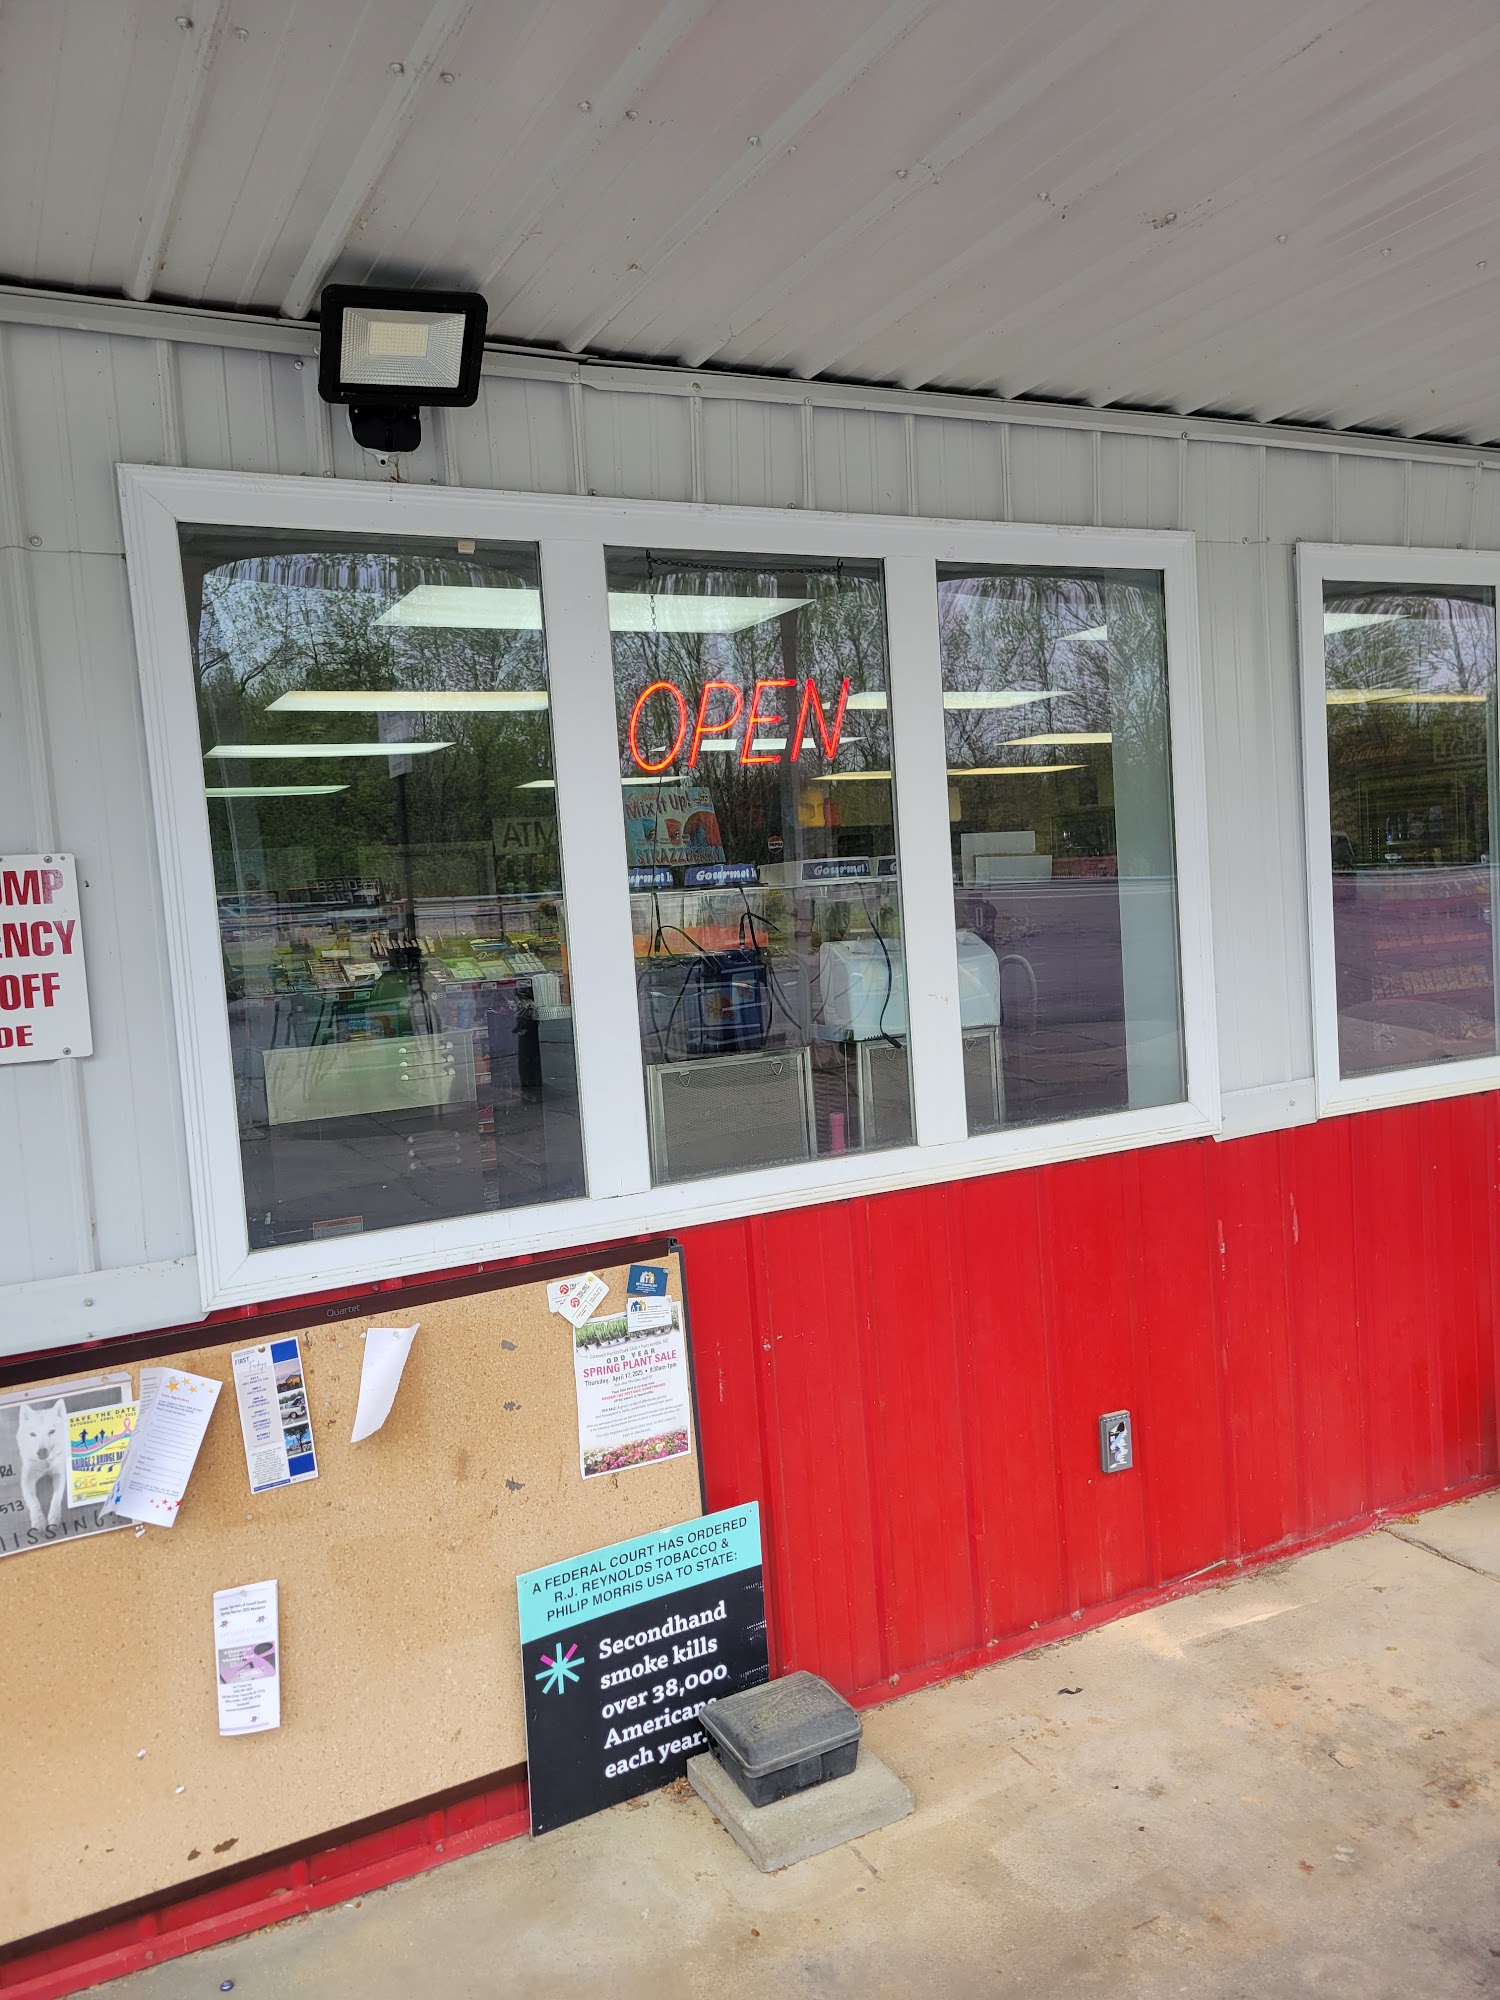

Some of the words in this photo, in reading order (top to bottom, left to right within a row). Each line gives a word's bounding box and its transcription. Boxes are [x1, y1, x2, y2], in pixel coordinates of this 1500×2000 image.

[628, 677, 850, 773] OPEN
[625, 801, 656, 821] Mix
[669, 790, 692, 813] Up!
[502, 820, 556, 848] ATM
[696, 869, 750, 881] Gourmet
[814, 864, 865, 876] Gourmet
[0, 869, 64, 906] MP
[0, 920, 76, 959] NCY
[0, 972, 61, 1010] OFF
[326, 1304, 361, 1317] Quartet
[234, 1356, 250, 1366] FIRST
[583, 1363, 620, 1378] SPRING
[622, 1356, 653, 1371] PLANT
[655, 1349, 677, 1363] SALE
[606, 1354, 625, 1364] ODD
[631, 1347, 656, 1359] YEAR
[612, 1373, 625, 1382] April
[632, 1369, 643, 1378] 2025
[70, 1415, 91, 1423] SAVE
[115, 1406, 136, 1415] DATE
[96, 1453, 116, 1465] BRIDGE
[532, 1583, 541, 1594] A
[544, 1561, 606, 1591] FEDERAL
[610, 1545, 655, 1568] COURT
[658, 1536, 684, 1553] HAS
[687, 1516, 748, 1544] ORDERED
[554, 1588, 578, 1603] R.J.
[582, 1561, 652, 1593] REYNOLDS
[655, 1541, 717, 1567] TOBACCO
[721, 1538, 729, 1549] &
[547, 1598, 588, 1622] PHILIP
[592, 1581, 643, 1608] MORRIS
[647, 1571, 673, 1589] USA
[676, 1564, 693, 1579] TO
[696, 1551, 737, 1573] STATE:
[599, 1600, 727, 1659] Secondhand
[600, 1647, 668, 1689] smoke
[673, 1636, 718, 1669] kills
[602, 1691, 648, 1719] over
[652, 1665, 728, 1705] 38,000
[605, 1748, 654, 1779] each
[658, 1730, 708, 1764] year.
